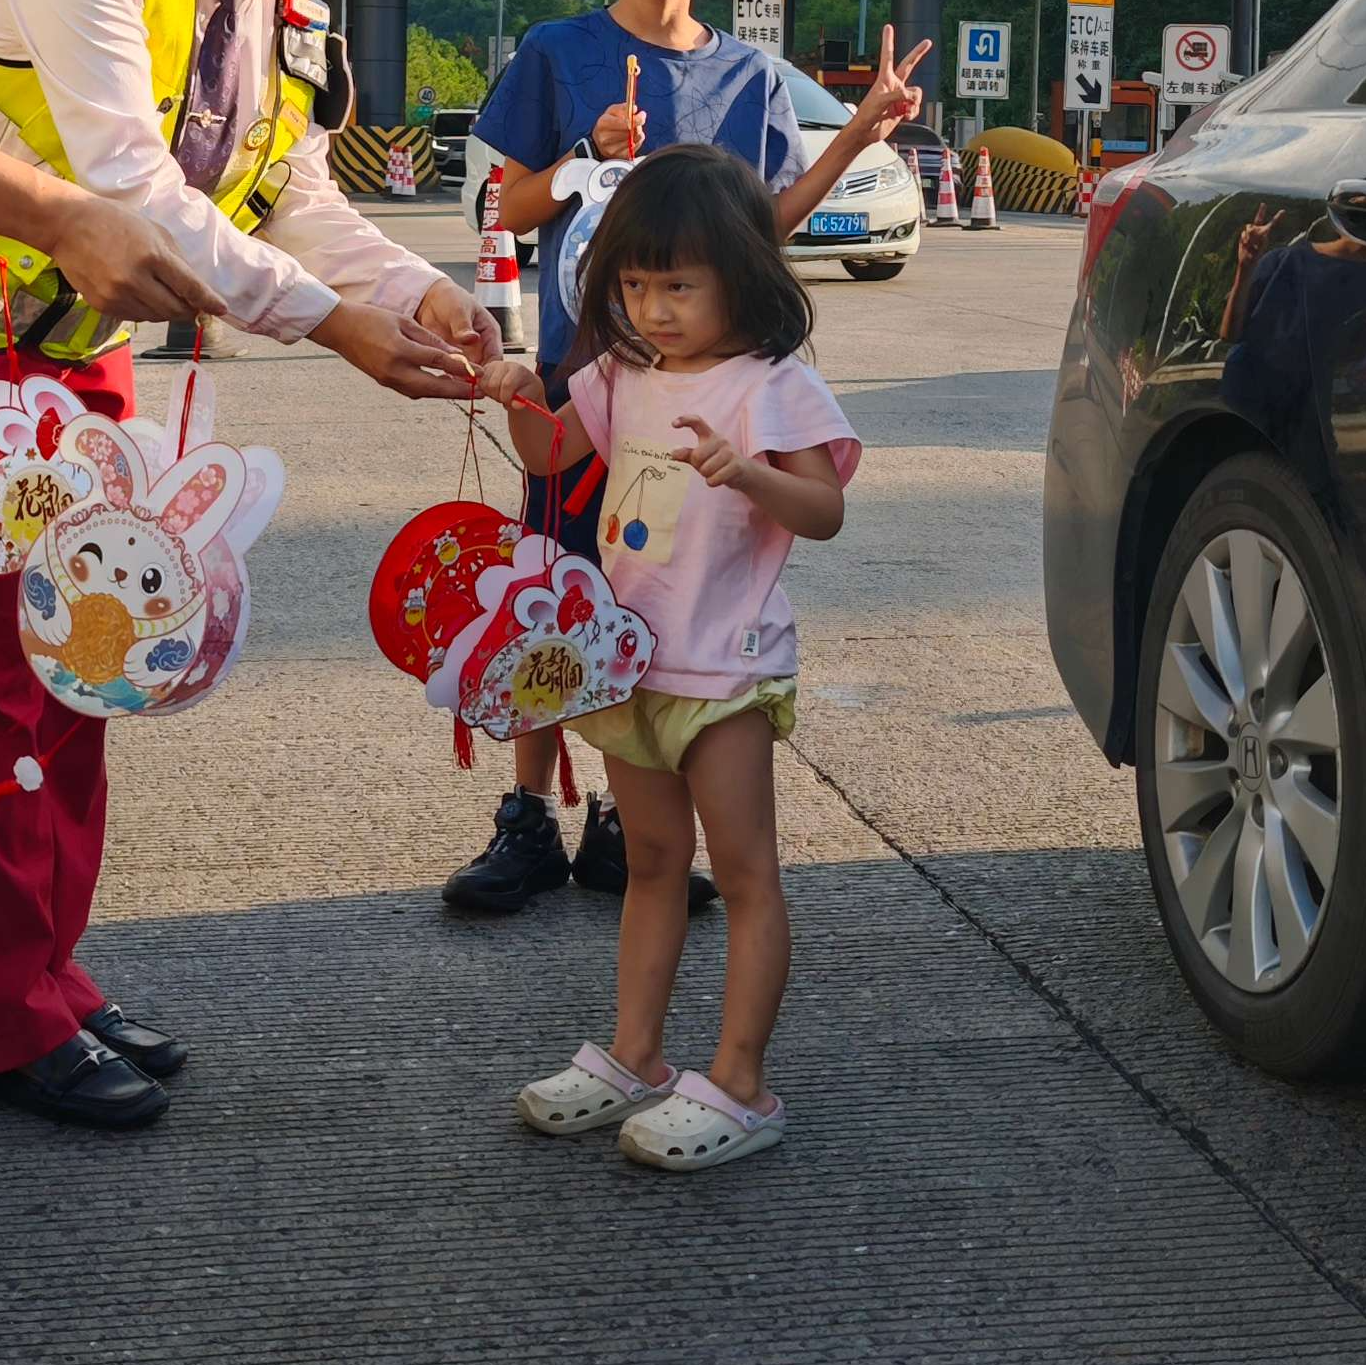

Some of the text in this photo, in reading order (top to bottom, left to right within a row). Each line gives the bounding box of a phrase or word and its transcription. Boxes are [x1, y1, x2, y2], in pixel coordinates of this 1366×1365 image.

[1070, 39, 1109, 57] 保持车距
[421, 90, 433, 102] 40
